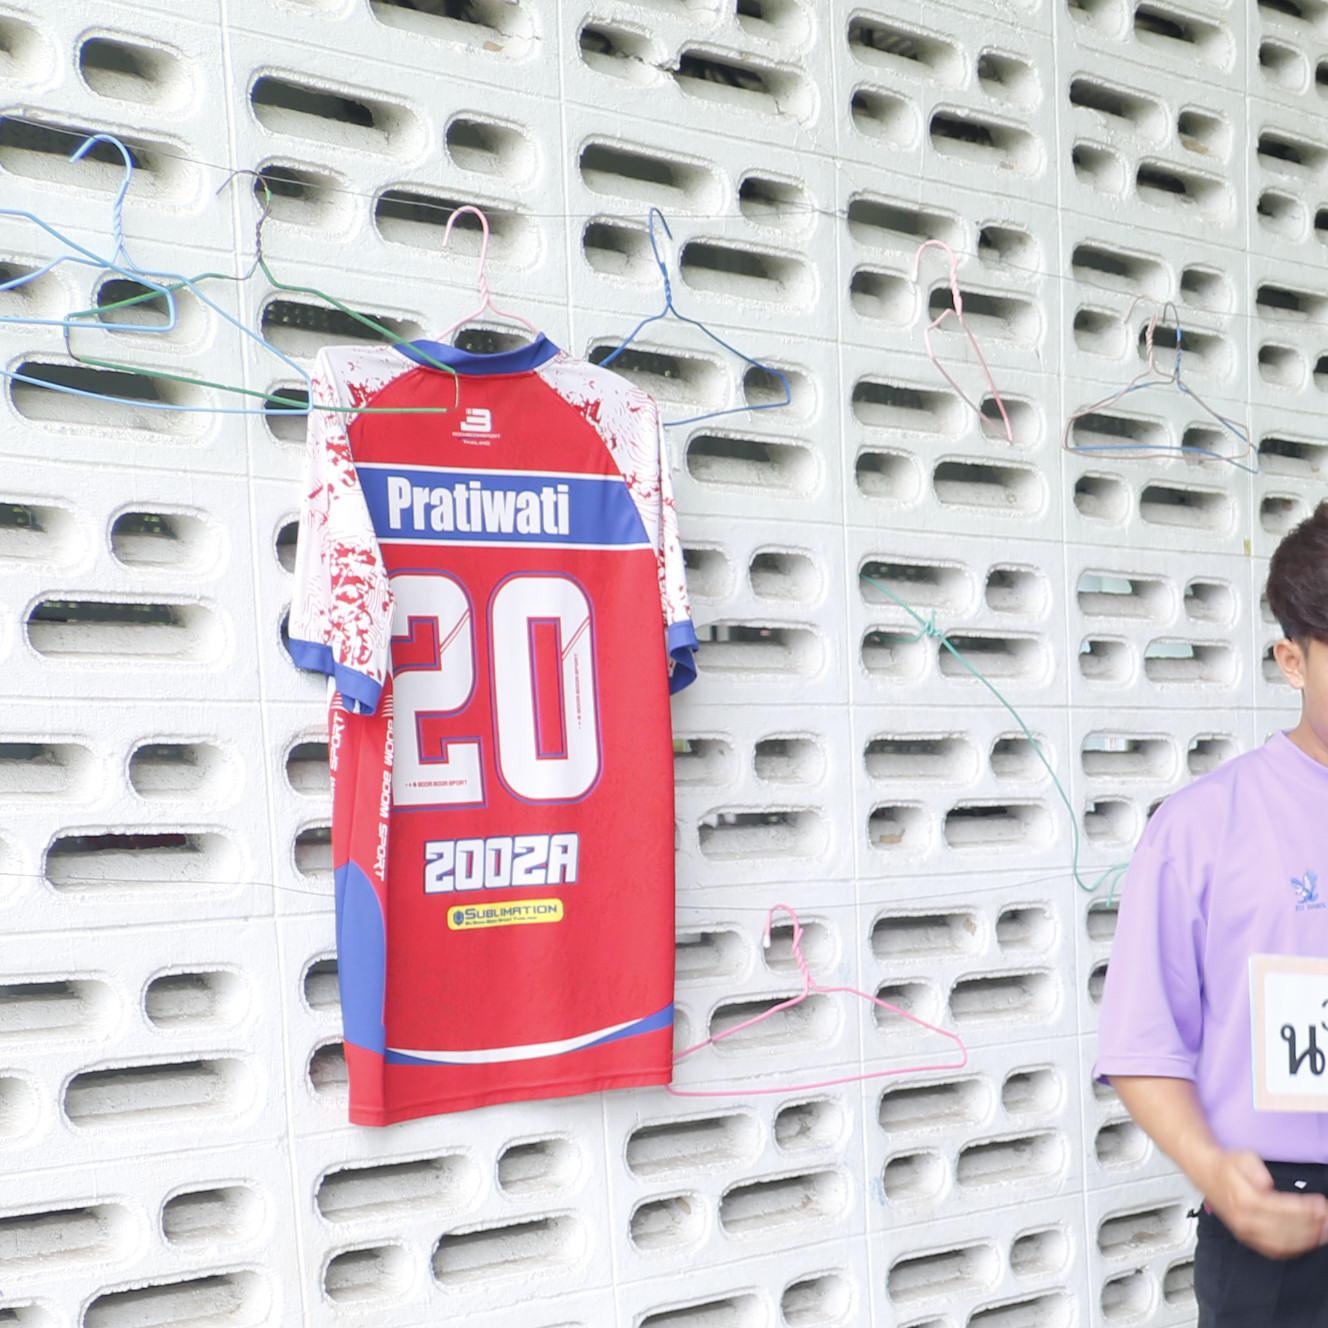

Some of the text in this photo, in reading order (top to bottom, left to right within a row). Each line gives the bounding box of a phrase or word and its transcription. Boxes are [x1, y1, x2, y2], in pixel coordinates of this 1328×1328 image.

[387, 476, 570, 535] Pratiwati
[389, 570, 602, 808] 20
[380, 770, 391, 818] BOOM
[373, 823, 388, 881] SPORT
[464, 905, 557, 920] SUBLIMATION
